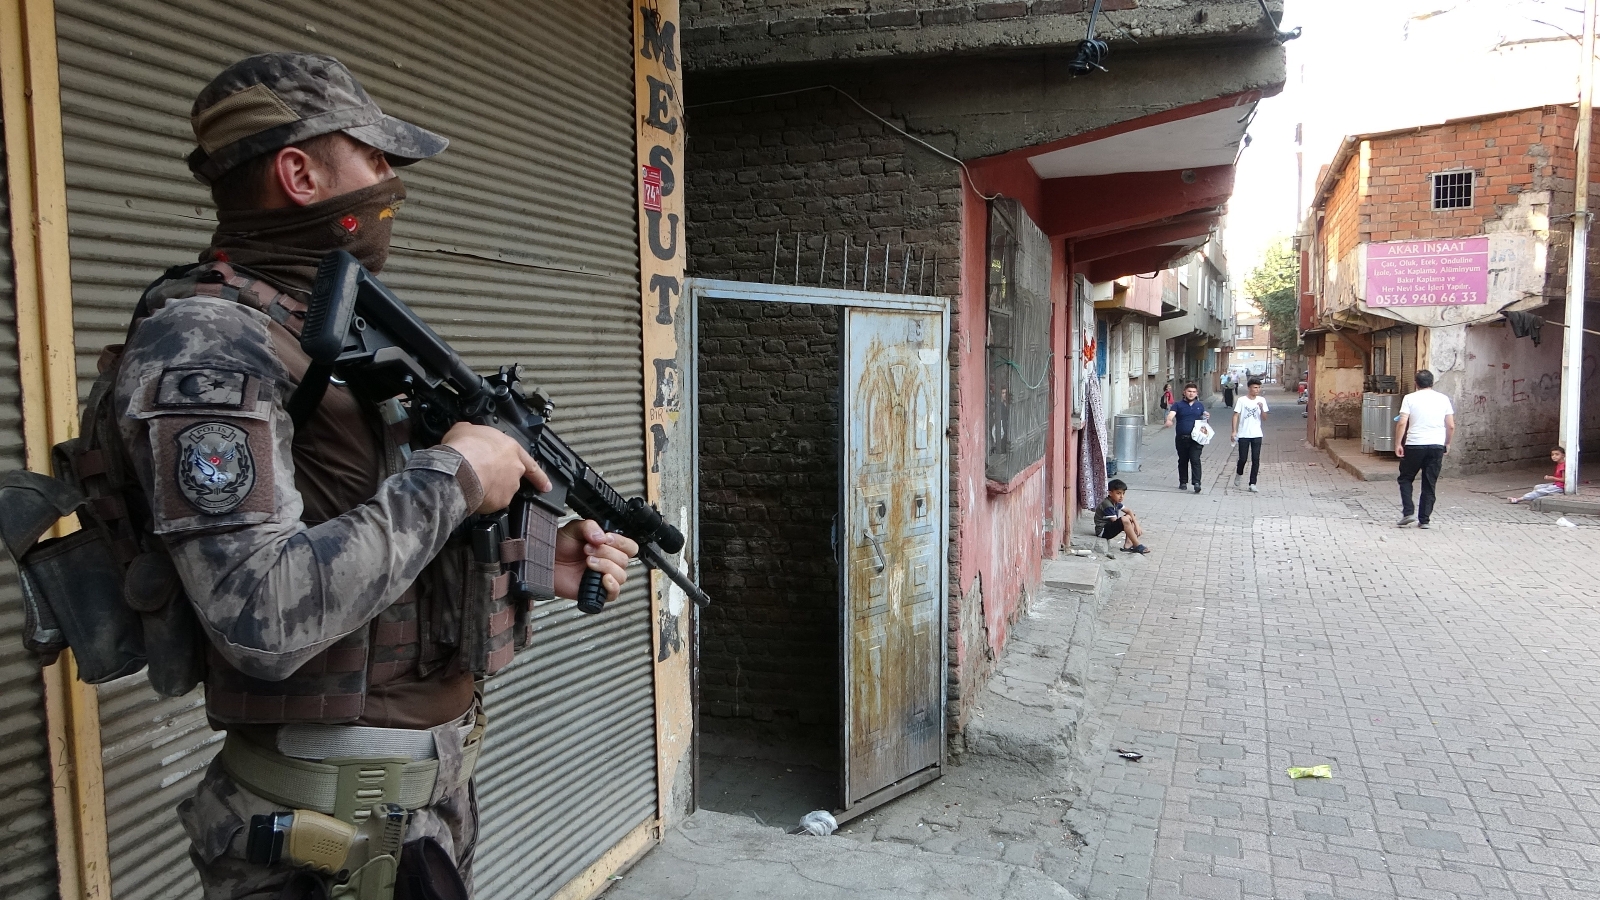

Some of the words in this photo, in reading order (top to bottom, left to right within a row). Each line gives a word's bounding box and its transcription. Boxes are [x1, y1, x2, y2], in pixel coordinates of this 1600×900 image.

[640, 6, 680, 326] MESUT
[1388, 244, 1420, 255] AKAR
[1423, 241, 1466, 254] İNŞAAT
[1399, 259, 1418, 267] Oluk,
[1421, 258, 1439, 266] Etek,
[1440, 256, 1473, 265] Onduline
[1407, 267, 1438, 276] Kaplama,
[1440, 265, 1481, 274] Alüminyum
[1416, 275, 1446, 284] Kaplama
[1414, 284, 1426, 292] Sac
[1376, 293, 1407, 305] 0536
[1411, 292, 1436, 304] 940
[1440, 292, 1456, 303] 66
[1460, 291, 1478, 303] 33
